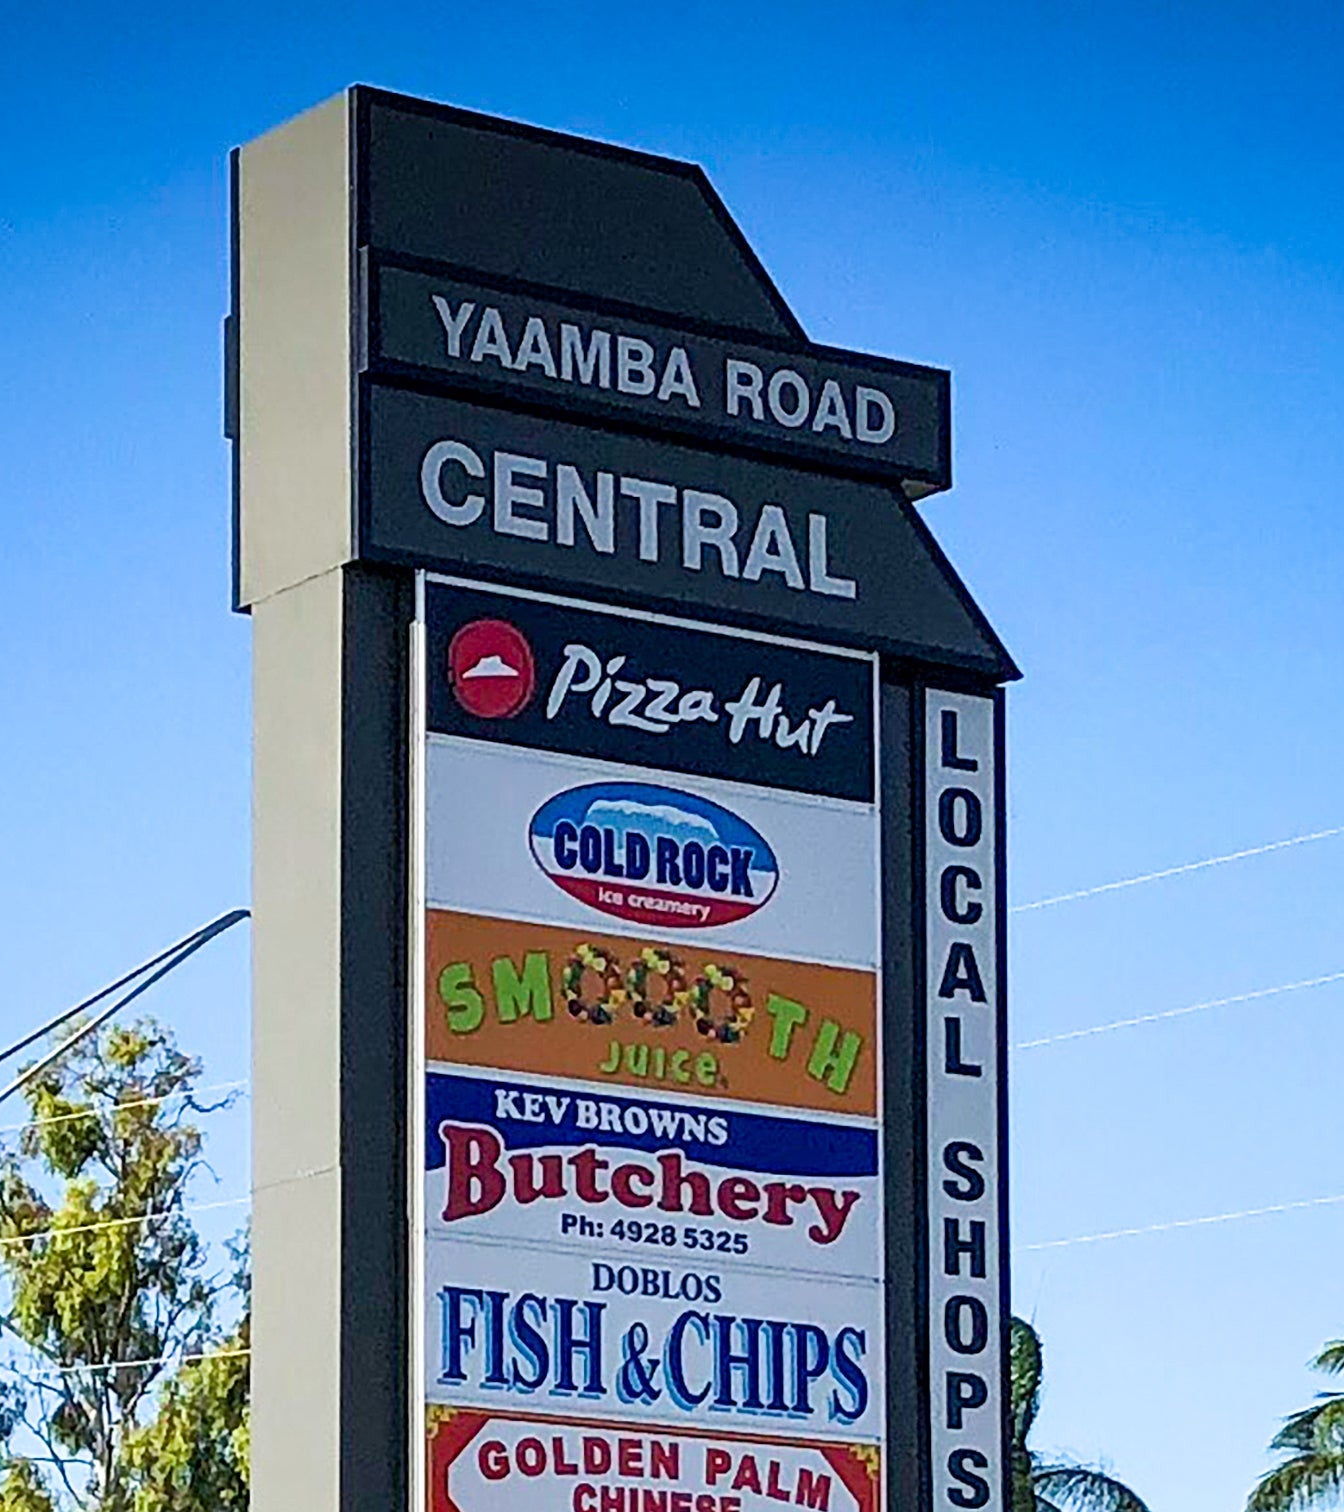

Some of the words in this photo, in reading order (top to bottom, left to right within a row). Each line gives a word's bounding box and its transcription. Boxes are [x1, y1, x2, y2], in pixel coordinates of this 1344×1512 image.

[432, 295, 700, 407] YAAMBA
[727, 359, 895, 444] ROAD
[421, 439, 856, 598] CENTRAL
[547, 643, 718, 729] Pizza
[725, 676, 854, 755] Hut
[554, 821, 650, 880] COLD
[656, 836, 754, 898] ROCK
[627, 892, 711, 922] creamery
[939, 710, 988, 1078] LOCAL
[495, 1089, 569, 1125] KEV
[576, 1098, 728, 1145] BROWNS
[441, 1123, 860, 1246] Butchery
[561, 1213, 604, 1240] Ph:
[611, 1219, 678, 1246] 4928
[683, 1226, 748, 1255] 5325
[592, 1263, 721, 1303] DOBLOS
[942, 1142, 990, 1510] SHOPS
[437, 1285, 607, 1397] FISH
[663, 1310, 869, 1426] CHIPS
[479, 1438, 680, 1481] GOLDEN
[706, 1449, 831, 1512] PALM
